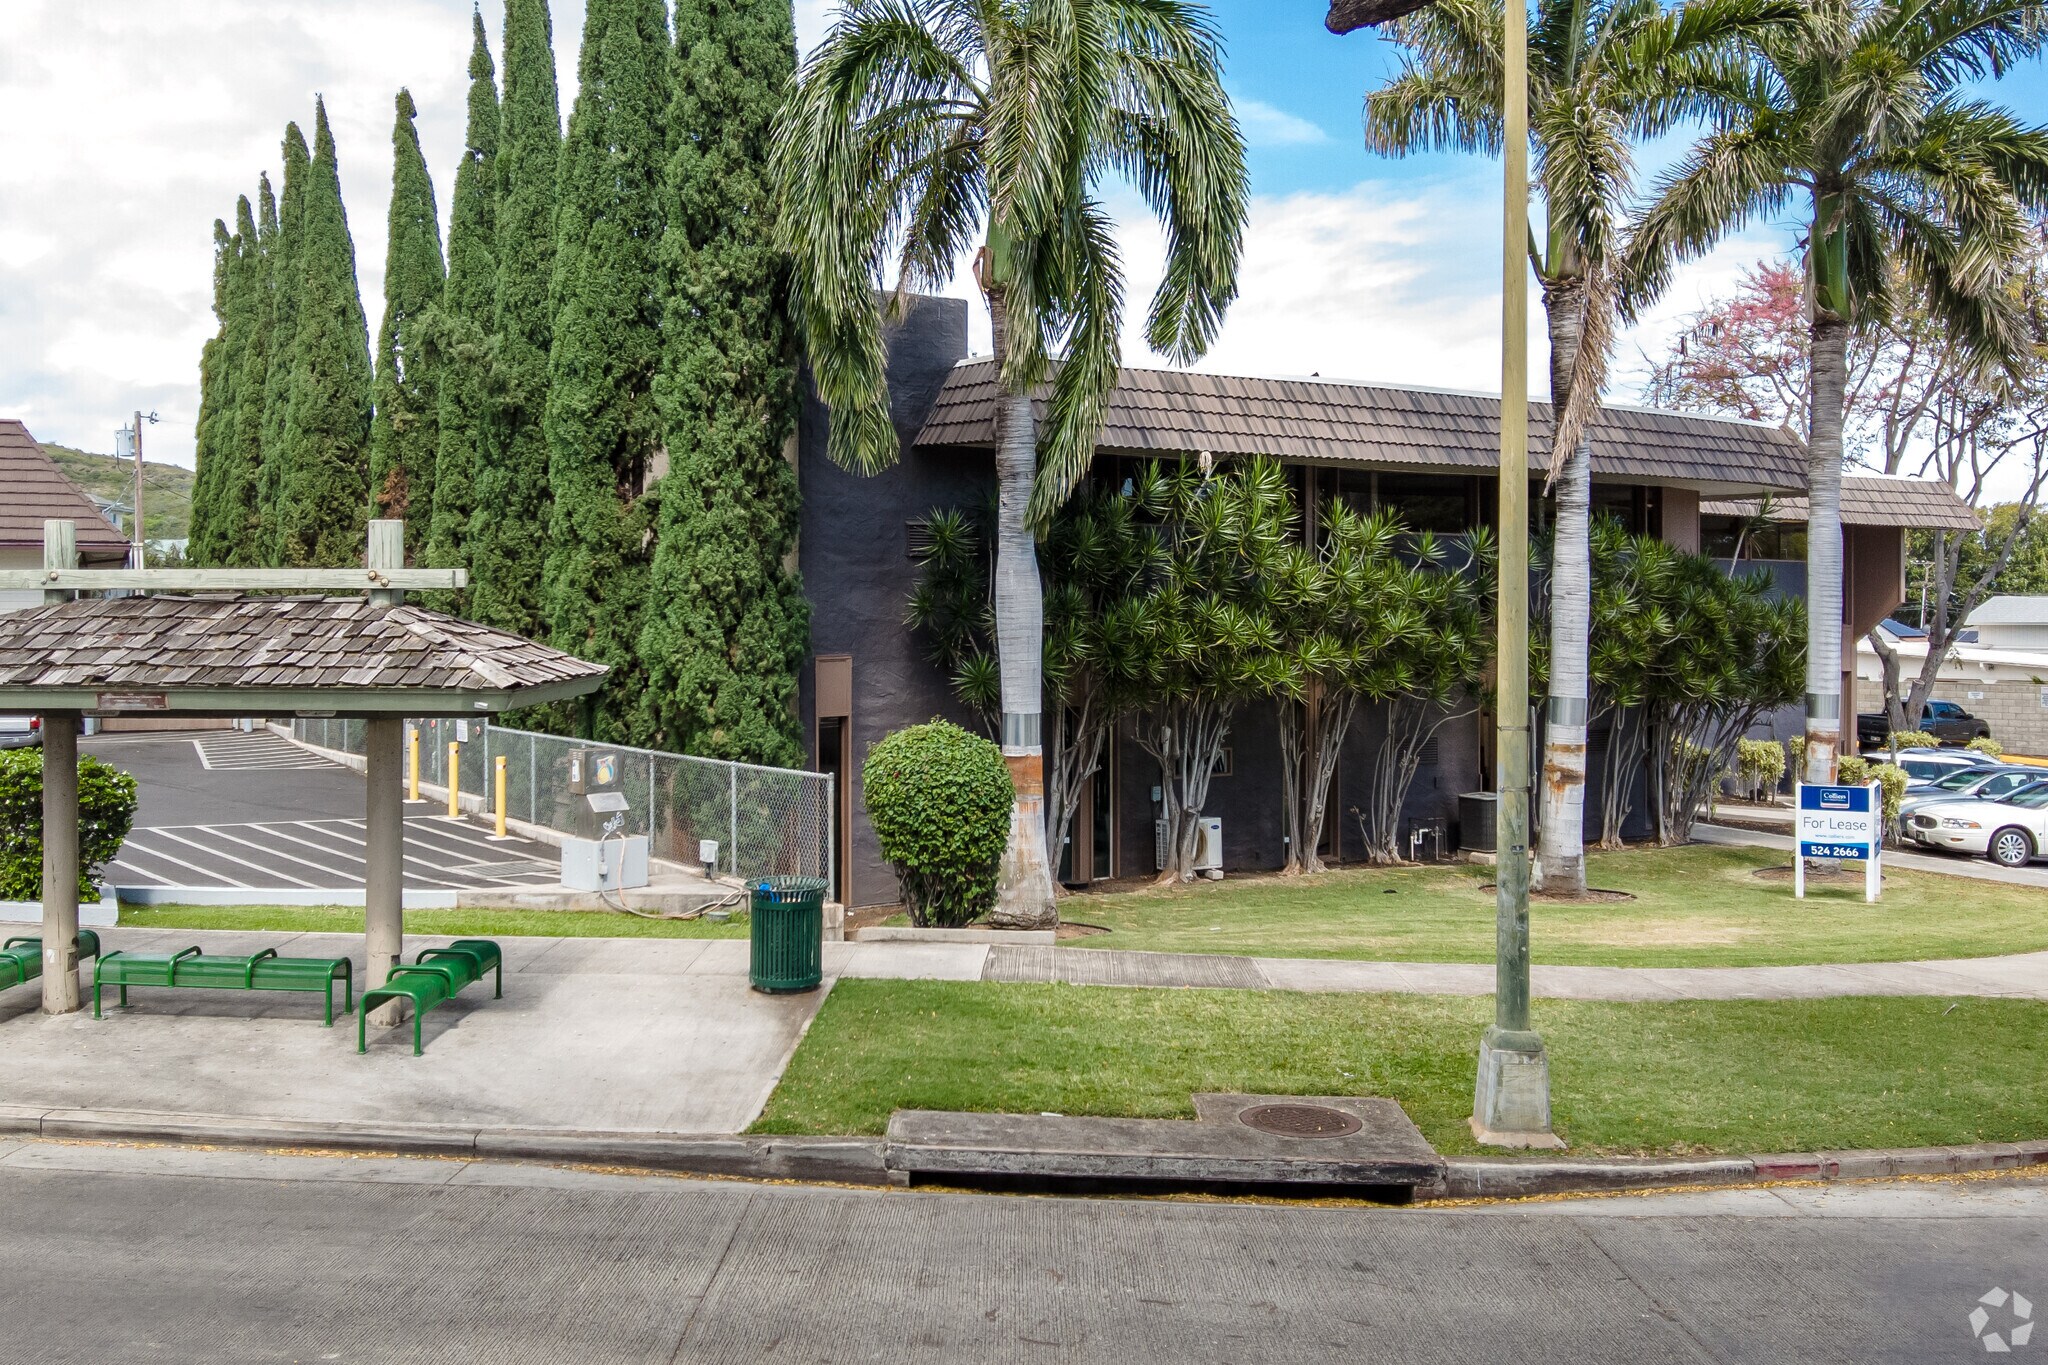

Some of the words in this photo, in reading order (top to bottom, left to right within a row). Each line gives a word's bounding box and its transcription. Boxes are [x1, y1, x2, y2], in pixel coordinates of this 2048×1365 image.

[1803, 816, 1825, 829] For
[1829, 817, 1867, 831] Lease
[1810, 845, 1830, 855] 524
[1833, 847, 1859, 857] 2666
